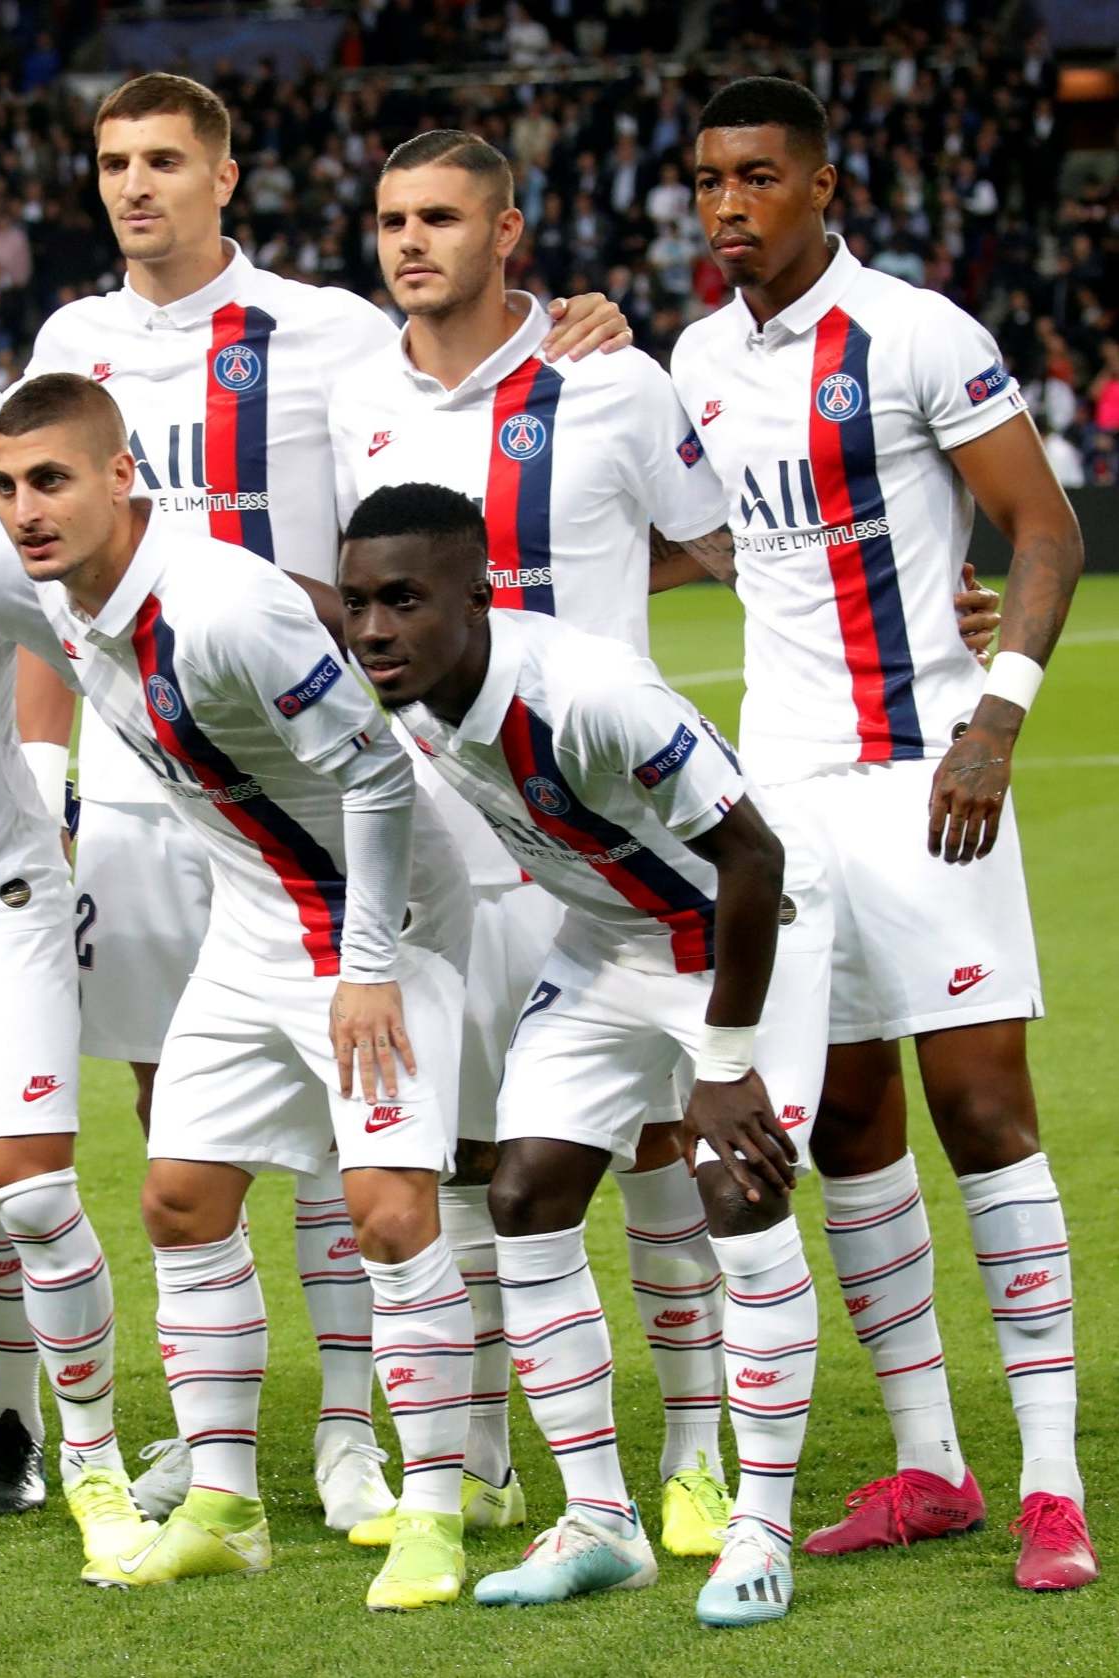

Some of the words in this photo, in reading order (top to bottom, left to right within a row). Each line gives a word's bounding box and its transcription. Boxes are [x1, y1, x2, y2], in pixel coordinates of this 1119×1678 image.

[222, 348, 252, 360] PARIS
[823, 375, 852, 389] PARIS
[508, 417, 537, 430] PARIS
[175, 493, 269, 513] LIMITLESS
[753, 536, 788, 553] LIVE
[792, 518, 890, 548] LIMITLESS
[296, 661, 337, 702] RESPECT
[655, 728, 693, 772] RESPECT
[954, 963, 983, 983] NIKE
[31, 1075, 57, 1089] NIKE
[372, 1105, 403, 1120] NIKE
[782, 1104, 807, 1119] NIKE
[1013, 1270, 1050, 1287] NIKE
[663, 1309, 700, 1322] NIKE
[64, 1360, 96, 1376] NIKE
[390, 1367, 417, 1381] NIKE
[741, 1367, 780, 1383] NIKE
